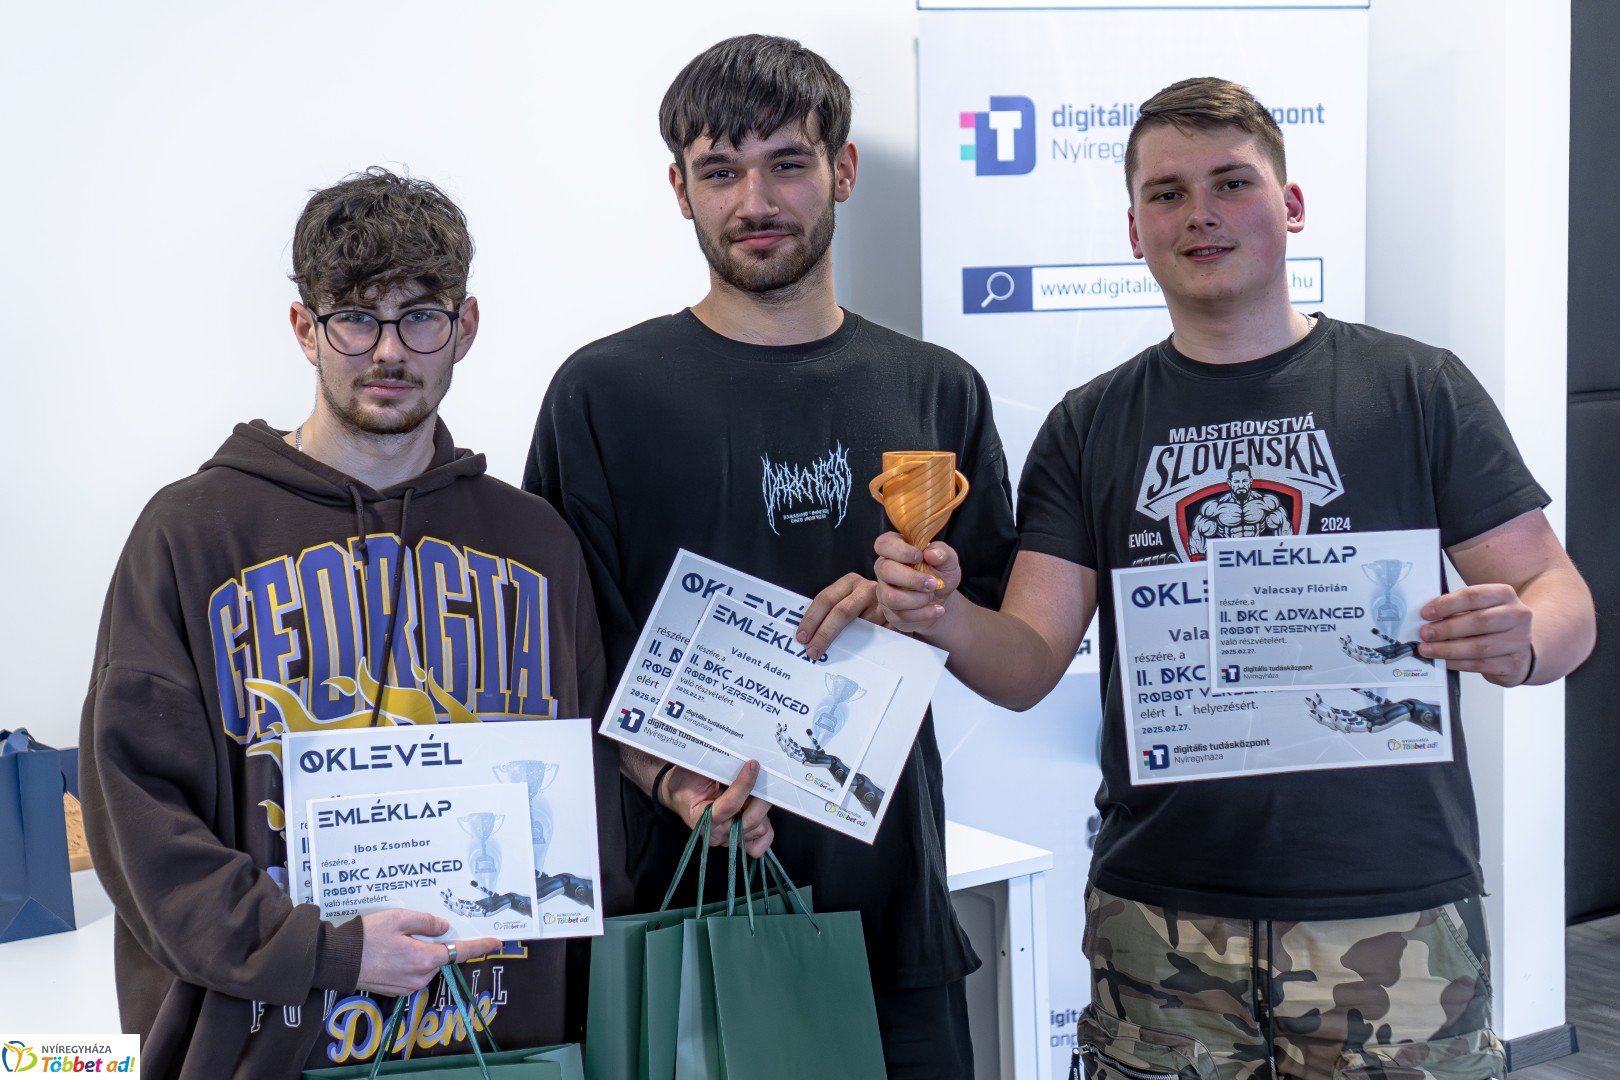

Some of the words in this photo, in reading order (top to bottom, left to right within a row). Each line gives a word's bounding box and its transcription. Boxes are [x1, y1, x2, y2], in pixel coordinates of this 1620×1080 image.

[1052, 137, 1125, 163] Nyíreg
[1041, 277, 1160, 299] www.digitalis
[1169, 412, 1316, 444] MAJSTROVSTVÁ
[1146, 431, 1338, 501] SLOVENSKA
[1321, 517, 1351, 532] 2024
[1219, 541, 1357, 567] EMLÉKLAP
[1131, 579, 1208, 608] OKL
[1253, 585, 1303, 595] Valacsay
[1307, 584, 1348, 593] Flórián
[1237, 610, 1268, 622] DKC
[1275, 607, 1365, 621] ADVANCED
[1168, 627, 1209, 642] Vala
[1220, 626, 1260, 635] ROBOT
[1264, 624, 1337, 634] VERSENYEN
[207, 532, 558, 746] GEORGIA
[1220, 637, 1238, 645] való
[731, 647, 761, 666] Valent
[763, 661, 791, 680] Ádám
[1134, 652, 1176, 663] részére,
[1179, 652, 1186, 660] a
[641, 659, 673, 678] ROB
[1136, 670, 1153, 686] II.
[1161, 665, 1207, 684] DKC
[636, 675, 660, 689] elért
[680, 677, 695, 687] való
[684, 666, 719, 687] ROBOT
[722, 683, 781, 716] VERSENYEN
[704, 660, 732, 680] DKC
[734, 676, 810, 715] ADVANCED
[630, 689, 660, 705] 2025.02
[1138, 689, 1194, 704] ROBOT
[1140, 708, 1166, 719] elért
[1193, 700, 1259, 716] helyezésért.
[643, 727, 687, 749] Nyíregyháza
[1141, 724, 1191, 735] 2025.02.27.
[1173, 743, 1208, 755] digitális
[1210, 738, 1271, 751] tudásközpont
[1174, 752, 1224, 764] Nyíregyháza
[318, 799, 452, 828] EMLÉKLAP
[353, 844, 378, 854] Ibos
[380, 839, 431, 851] Zsombor
[321, 859, 351, 868] részére,
[338, 868, 370, 883] DKC
[376, 859, 463, 879] ADVANCED
[323, 885, 362, 897] ROBOT
[366, 878, 437, 893] VERSENYEN
[324, 898, 341, 908] való
